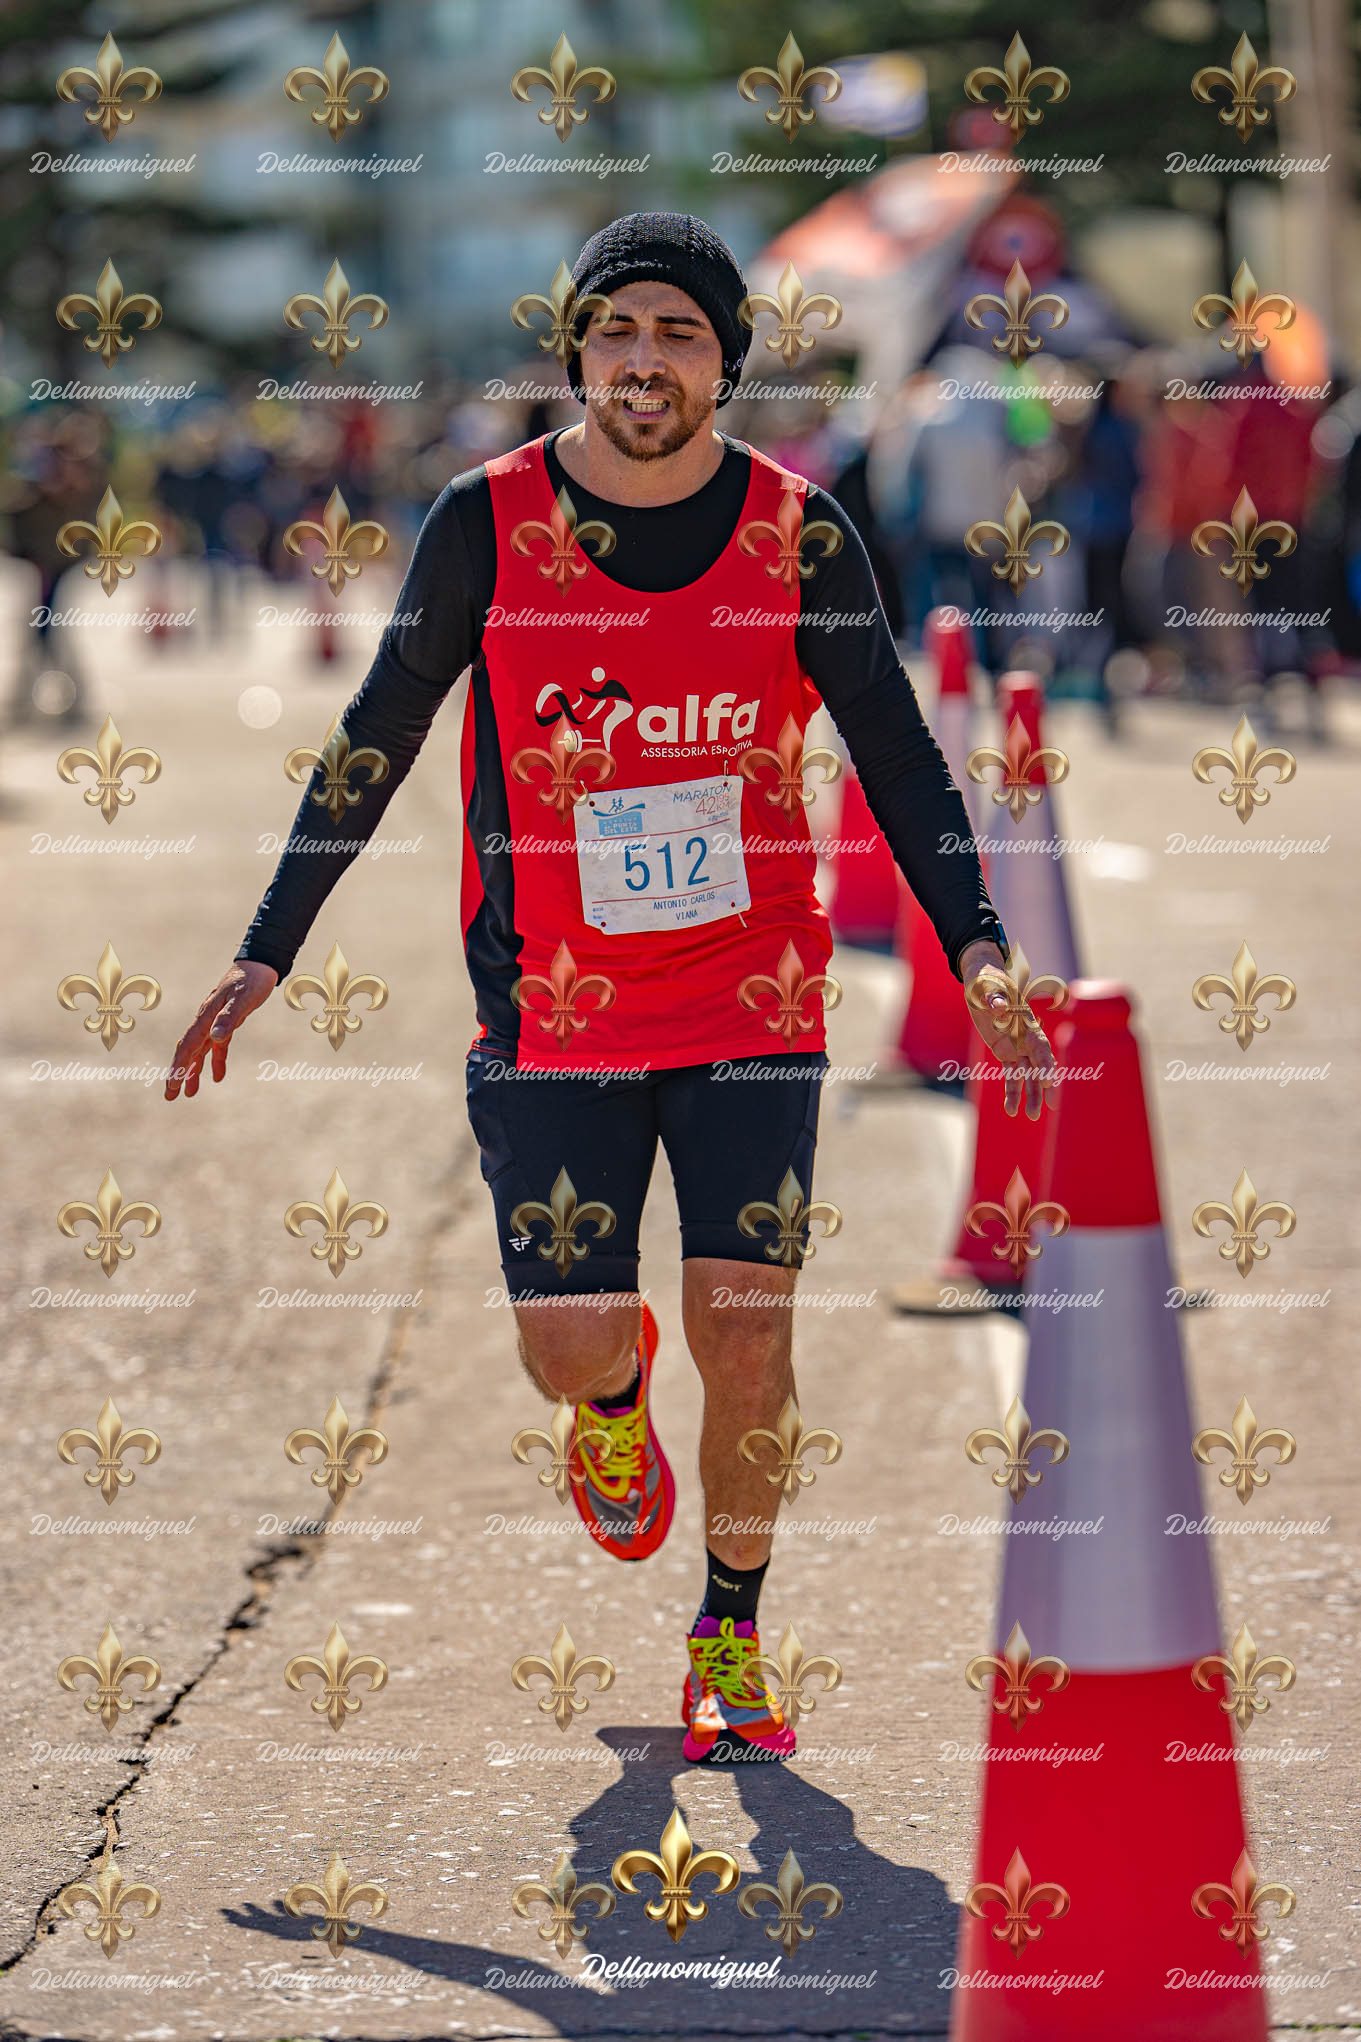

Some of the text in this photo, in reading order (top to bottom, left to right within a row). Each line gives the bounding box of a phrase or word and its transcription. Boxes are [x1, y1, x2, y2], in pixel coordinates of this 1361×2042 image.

[637, 692, 760, 743] alfa
[641, 746, 708, 758] ASSESSORIA
[696, 796, 716, 815] 42
[624, 837, 710, 891] 512
[653, 891, 715, 910] ANTONIO CARLOS
[675, 910, 698, 920] VIANA
